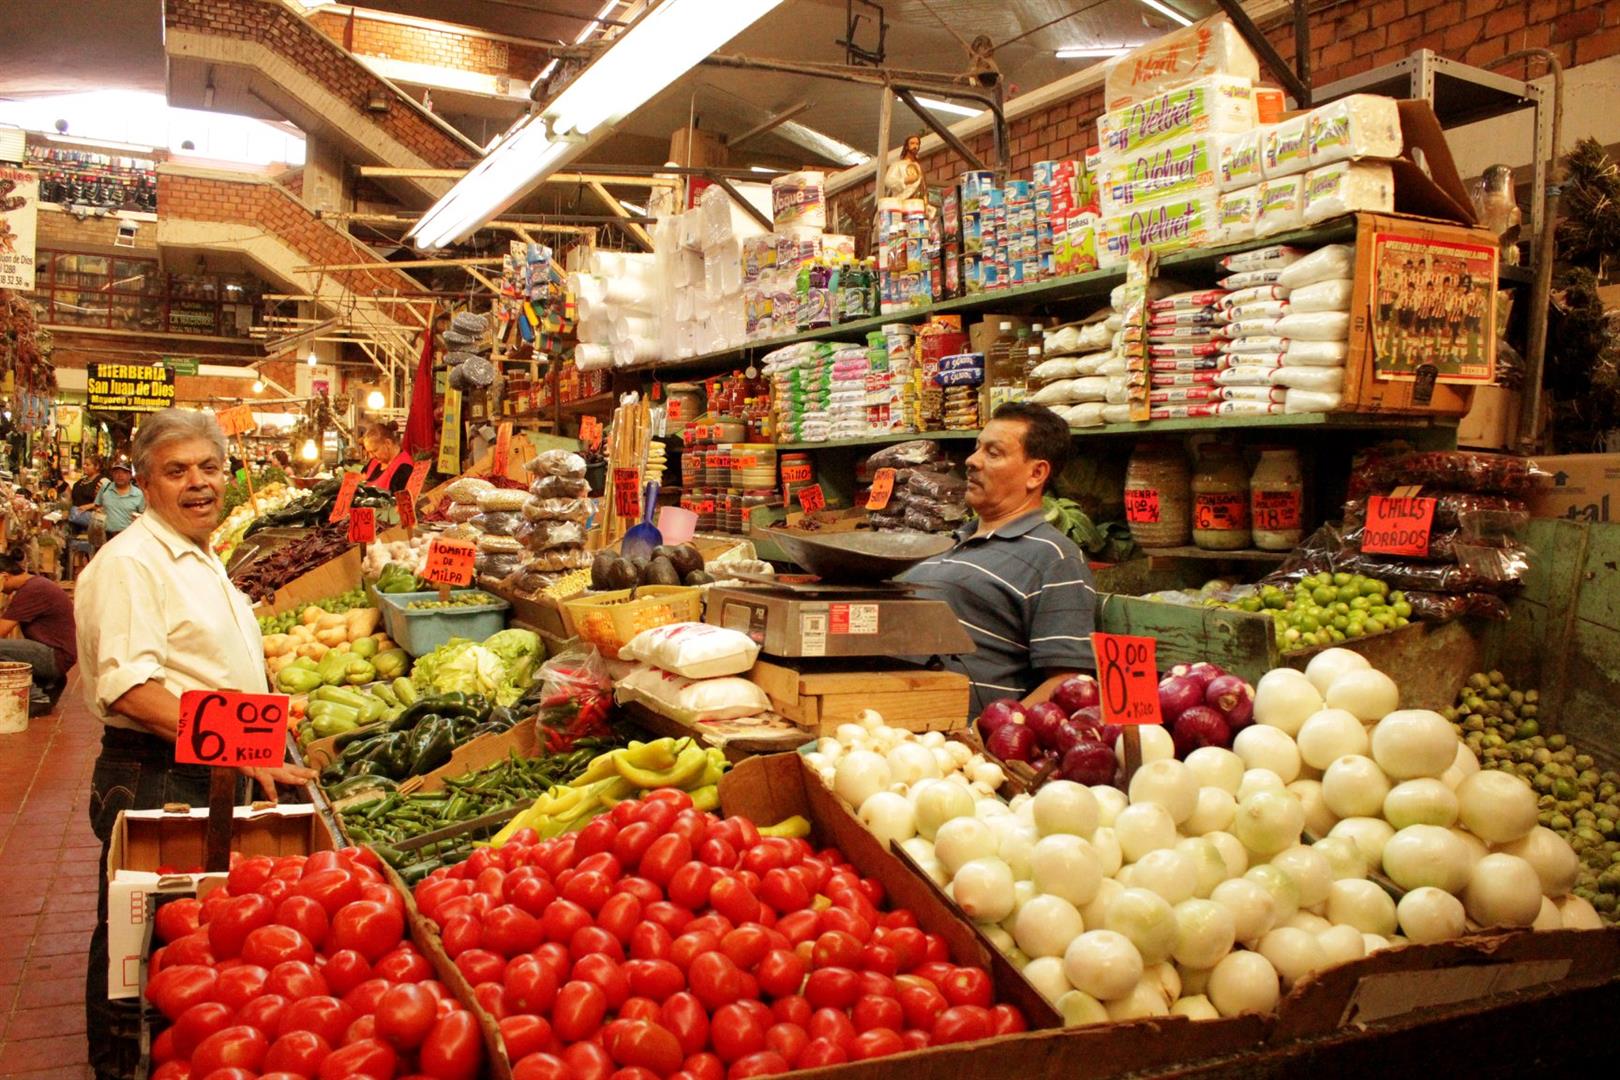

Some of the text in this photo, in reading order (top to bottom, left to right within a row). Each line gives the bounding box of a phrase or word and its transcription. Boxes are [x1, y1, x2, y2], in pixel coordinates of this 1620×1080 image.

[1129, 89, 1196, 138] Velvet
[1135, 144, 1200, 193] Velvet
[774, 190, 805, 213] Vogue
[1129, 202, 1195, 246] Velvet
[98, 363, 166, 381] HIERBERIA
[88, 378, 175, 397] San Juan de Dios
[91, 395, 171, 406] Mayoreo y Menudeo
[1378, 498, 1425, 520] CHILES
[1363, 529, 1428, 549] DORADOS
[443, 557, 453, 566] DE
